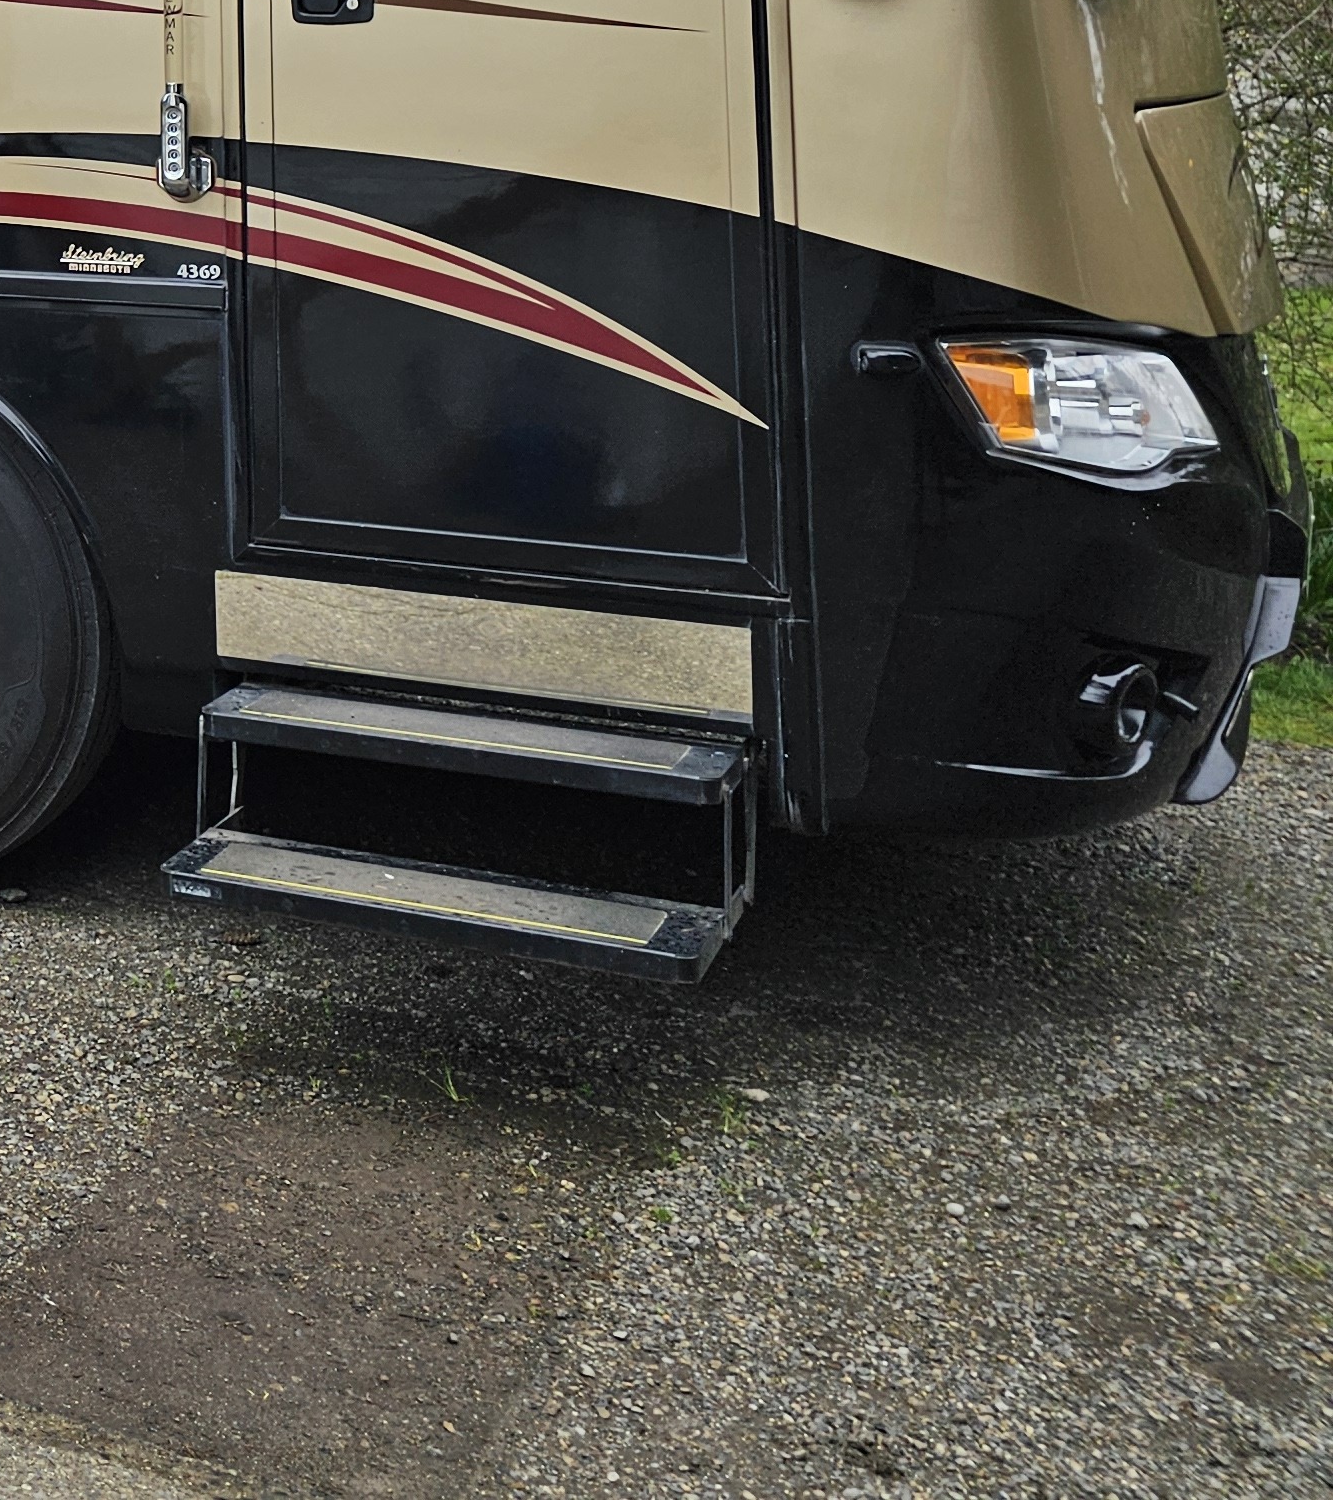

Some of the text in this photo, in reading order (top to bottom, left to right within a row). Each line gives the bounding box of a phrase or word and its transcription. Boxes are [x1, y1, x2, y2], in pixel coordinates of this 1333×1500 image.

[62, 243, 146, 269] Steinbring
[68, 263, 131, 274] MINNESOTA
[176, 264, 221, 279] 4369
